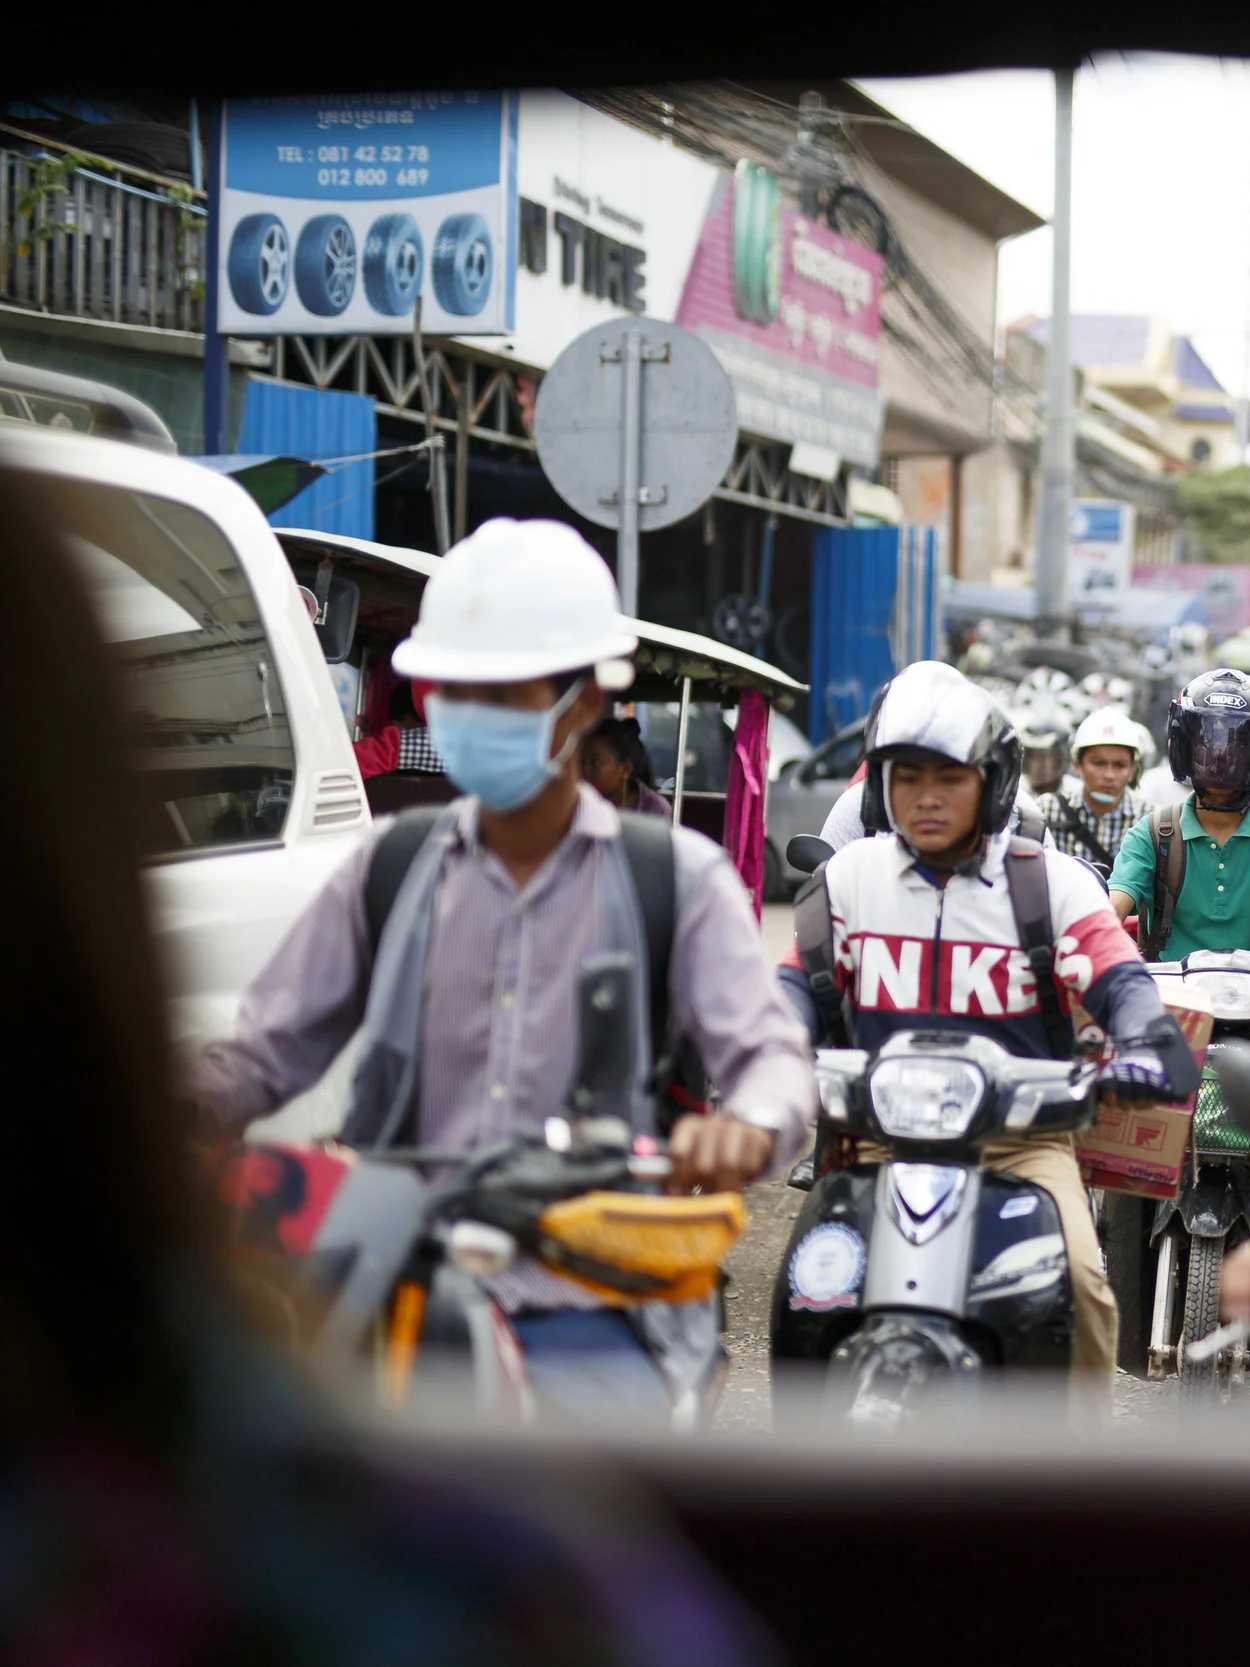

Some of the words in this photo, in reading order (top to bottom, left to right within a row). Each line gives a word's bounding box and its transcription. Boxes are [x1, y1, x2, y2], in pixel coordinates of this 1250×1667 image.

[277, 146, 303, 163] TEL
[318, 146, 348, 163] 081
[354, 145, 378, 163] 42
[380, 146, 402, 163] 52
[407, 146, 430, 163] 78
[318, 168, 350, 187] 012
[354, 168, 388, 187] 800
[396, 168, 430, 187] 689
[554, 209, 646, 314] TIRE
[1210, 695, 1241, 707] INDEX
